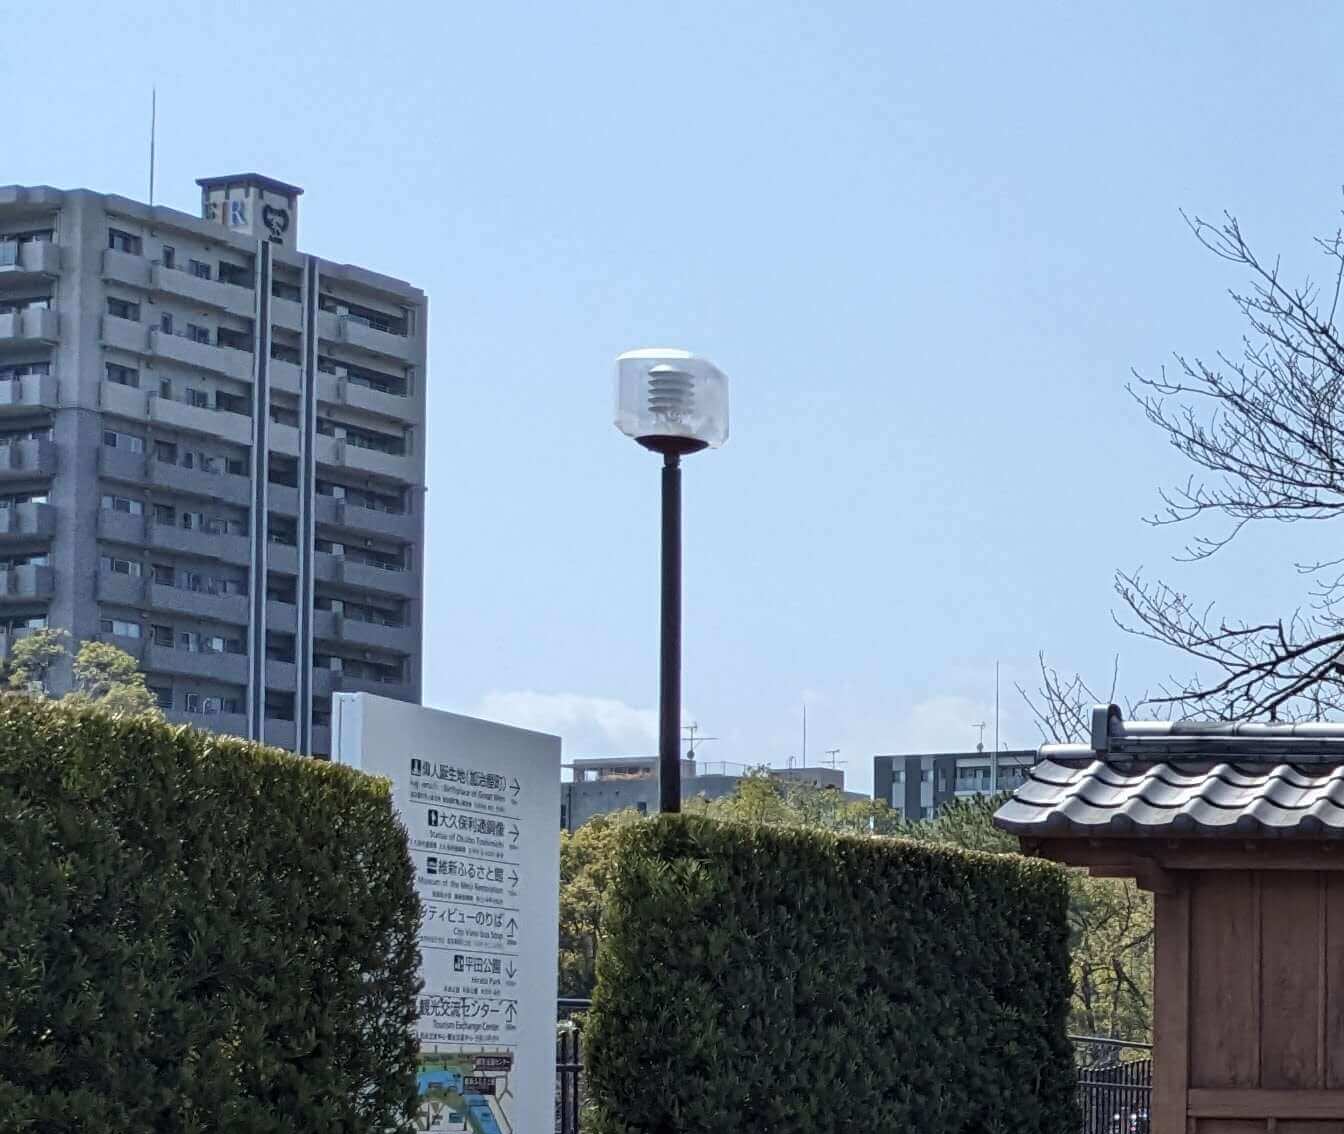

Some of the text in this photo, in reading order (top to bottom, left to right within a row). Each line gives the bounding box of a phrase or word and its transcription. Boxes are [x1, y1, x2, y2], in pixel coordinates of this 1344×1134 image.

[439, 859, 505, 882] 維新ふるさと館
[465, 956, 501, 974] 平田公園
